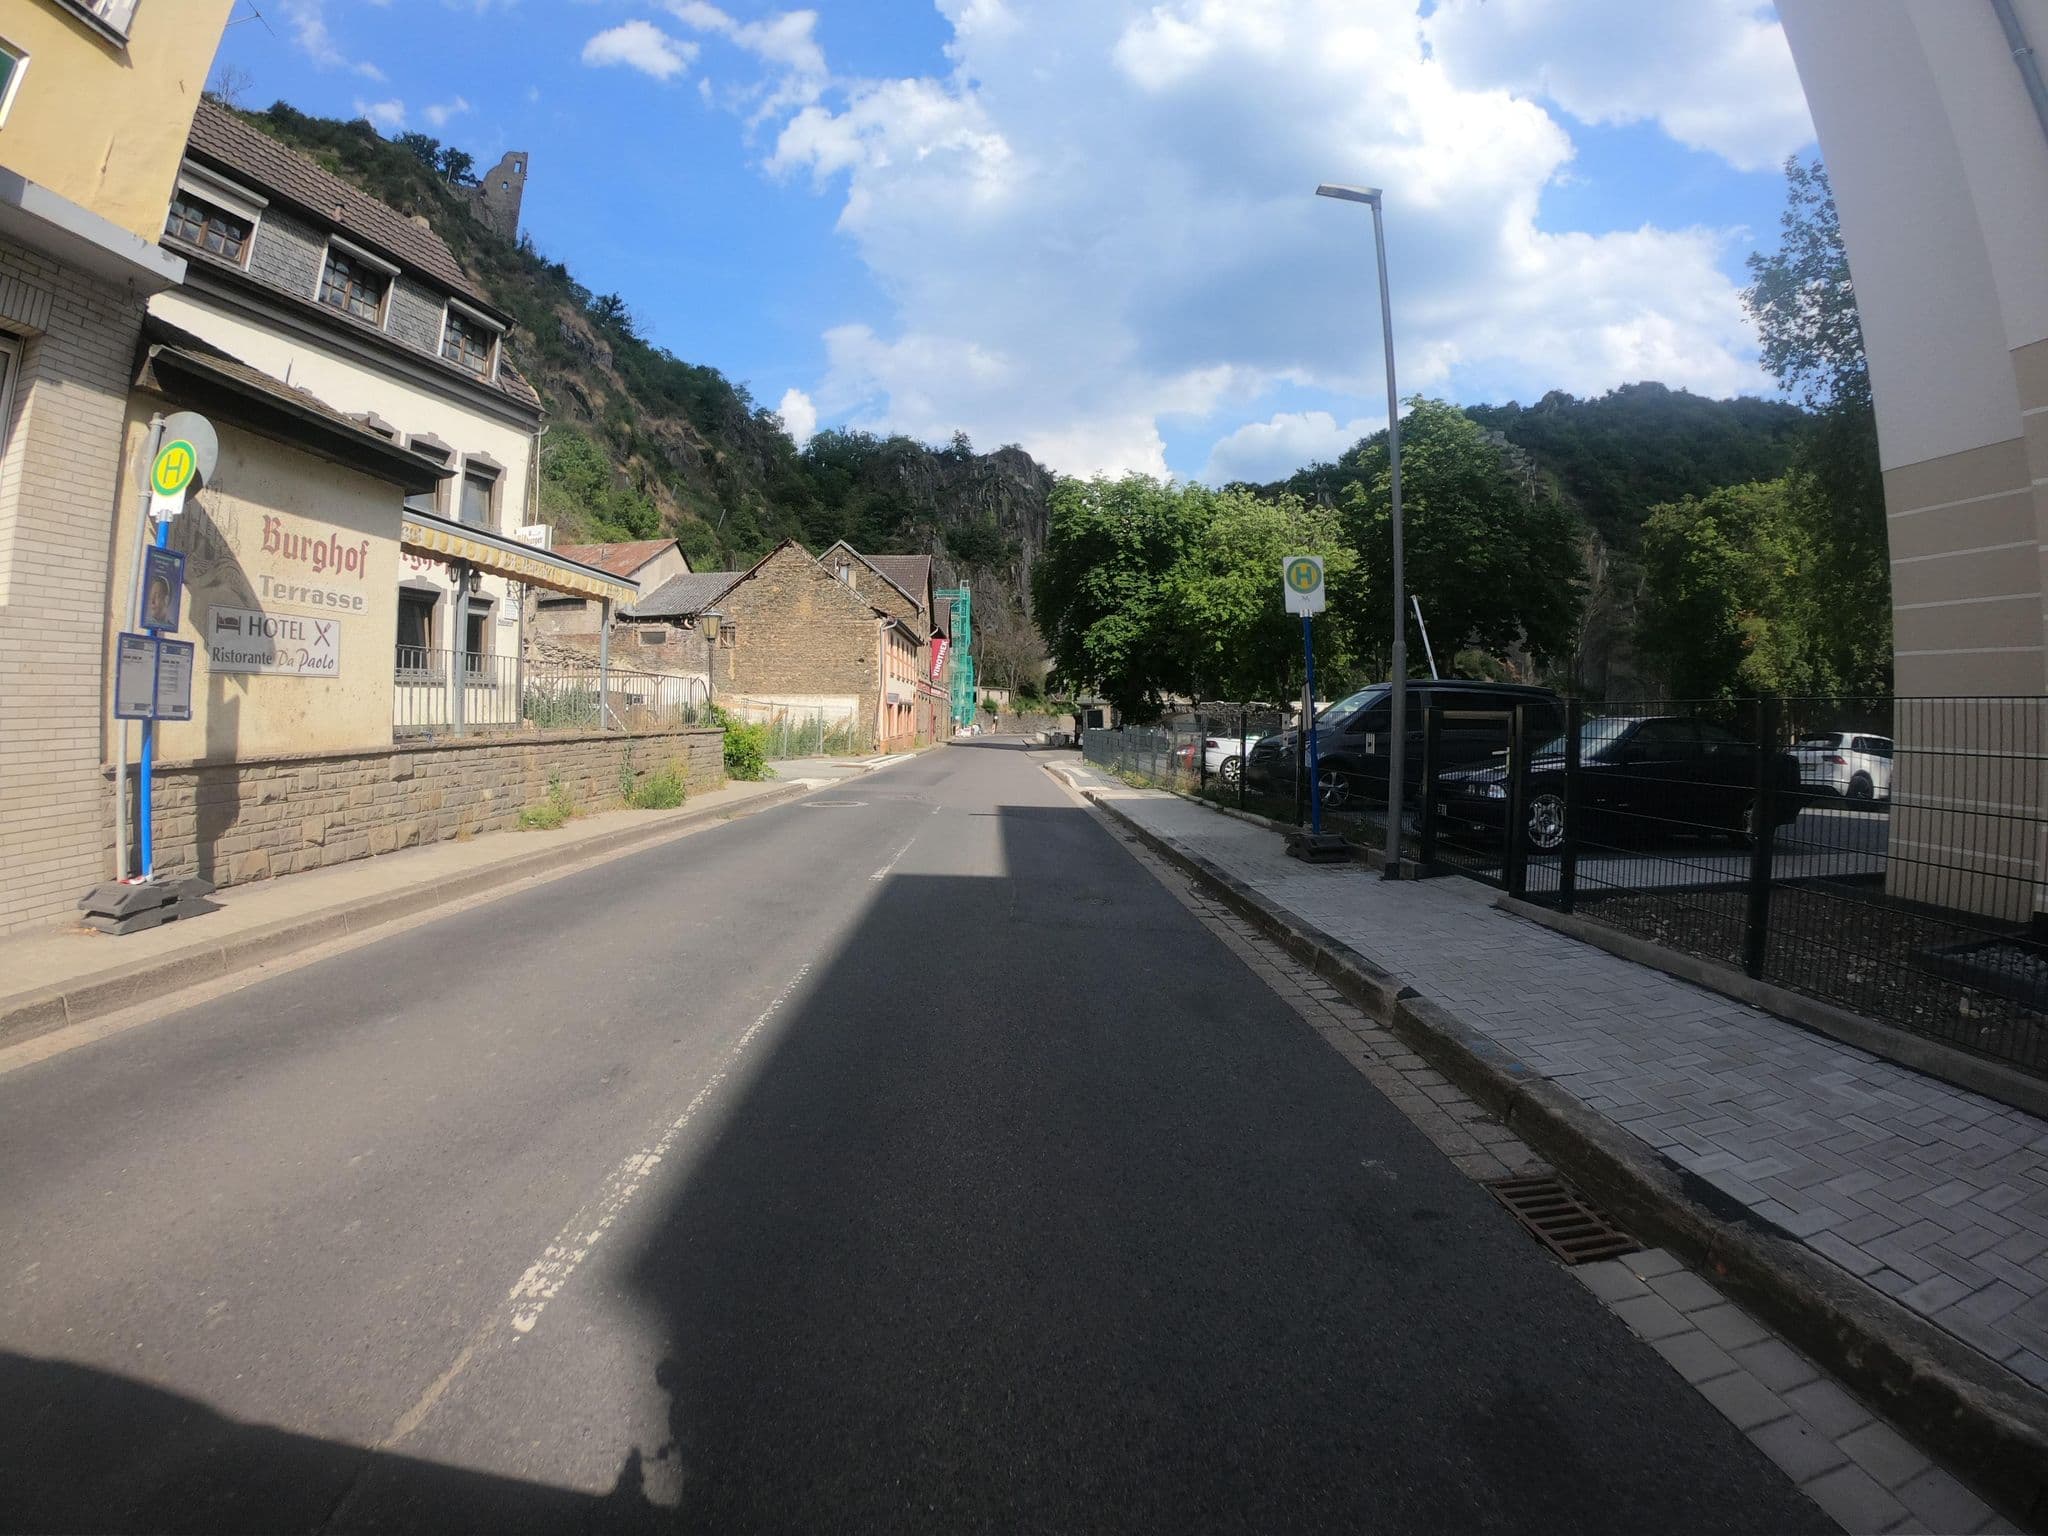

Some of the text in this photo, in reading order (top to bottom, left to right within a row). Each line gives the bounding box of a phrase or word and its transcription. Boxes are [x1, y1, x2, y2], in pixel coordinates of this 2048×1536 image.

[162, 452, 185, 485] H
[261, 514, 370, 580] Burghof
[1295, 566, 1313, 585] H
[259, 574, 365, 611] Terrasse
[249, 615, 307, 642] HOTEL
[212, 645, 334, 673] Ristorante Da Paolo
[933, 640, 949, 677] VINOTHEK
